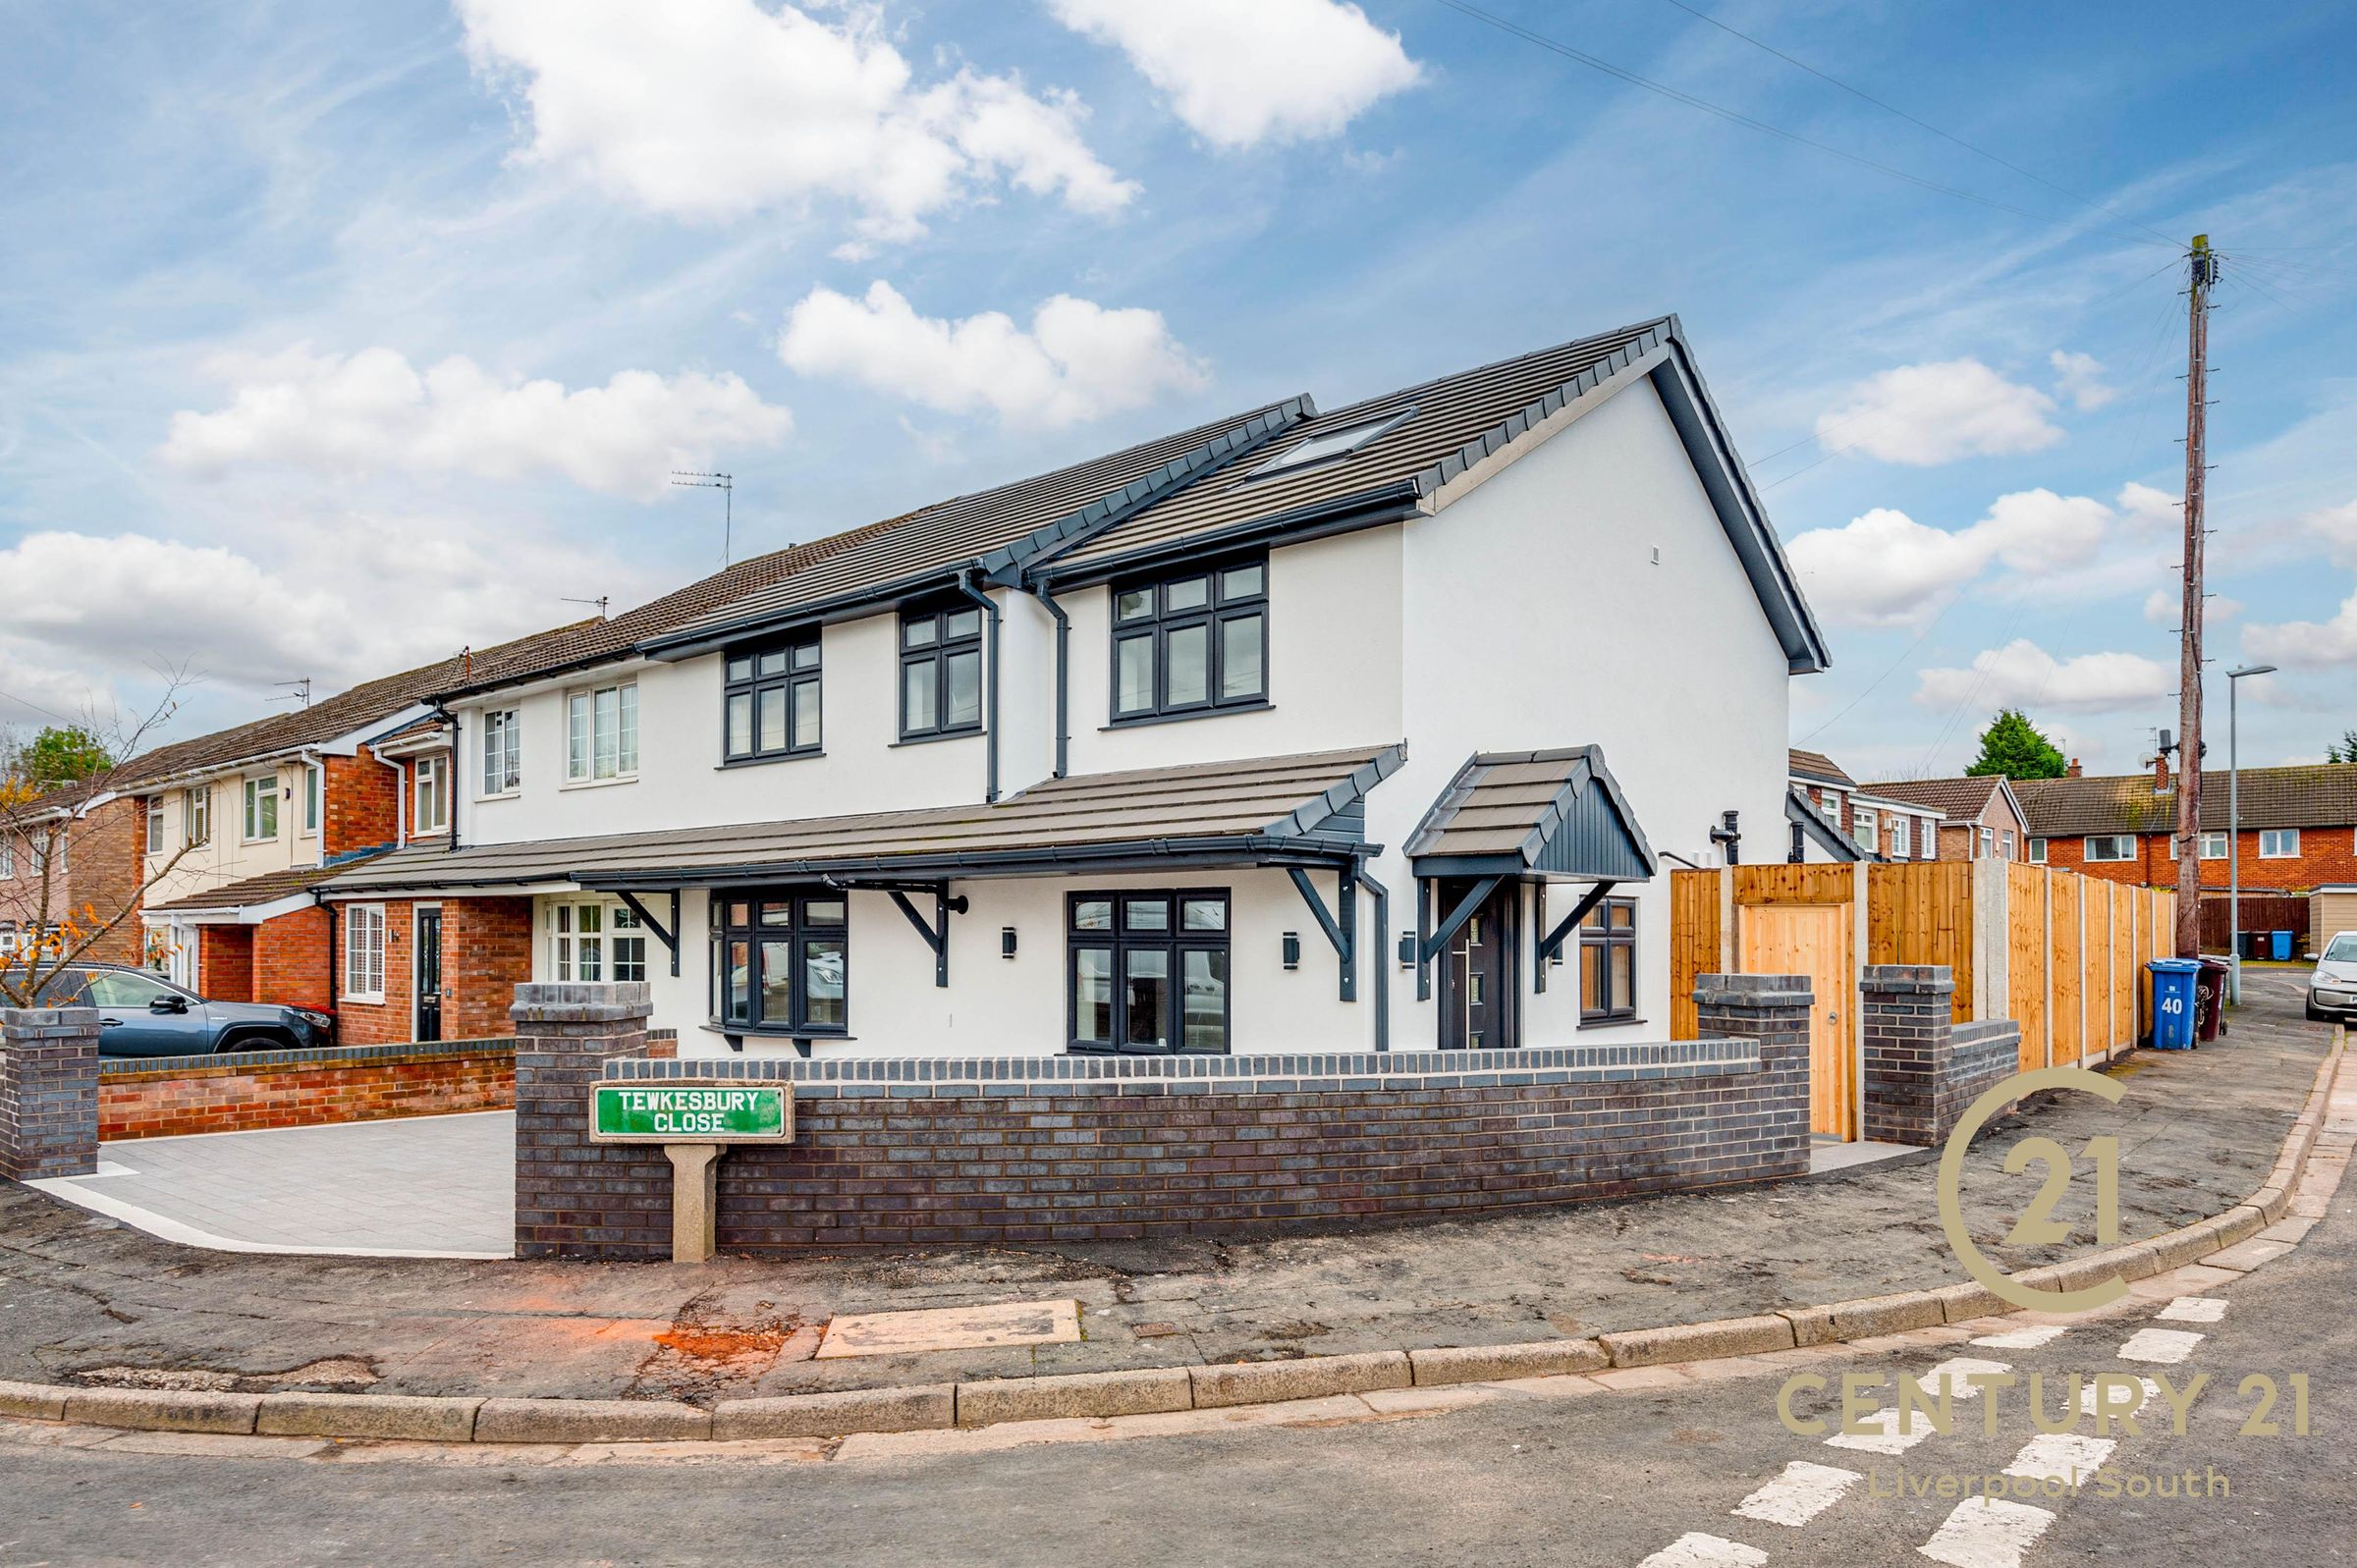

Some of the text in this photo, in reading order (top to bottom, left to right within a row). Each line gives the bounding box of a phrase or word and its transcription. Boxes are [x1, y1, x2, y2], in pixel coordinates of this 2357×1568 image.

[2162, 998, 2182, 1014] 40
[618, 1092, 759, 1110] TEWKESBURY
[654, 1113, 725, 1132] CLOSE
